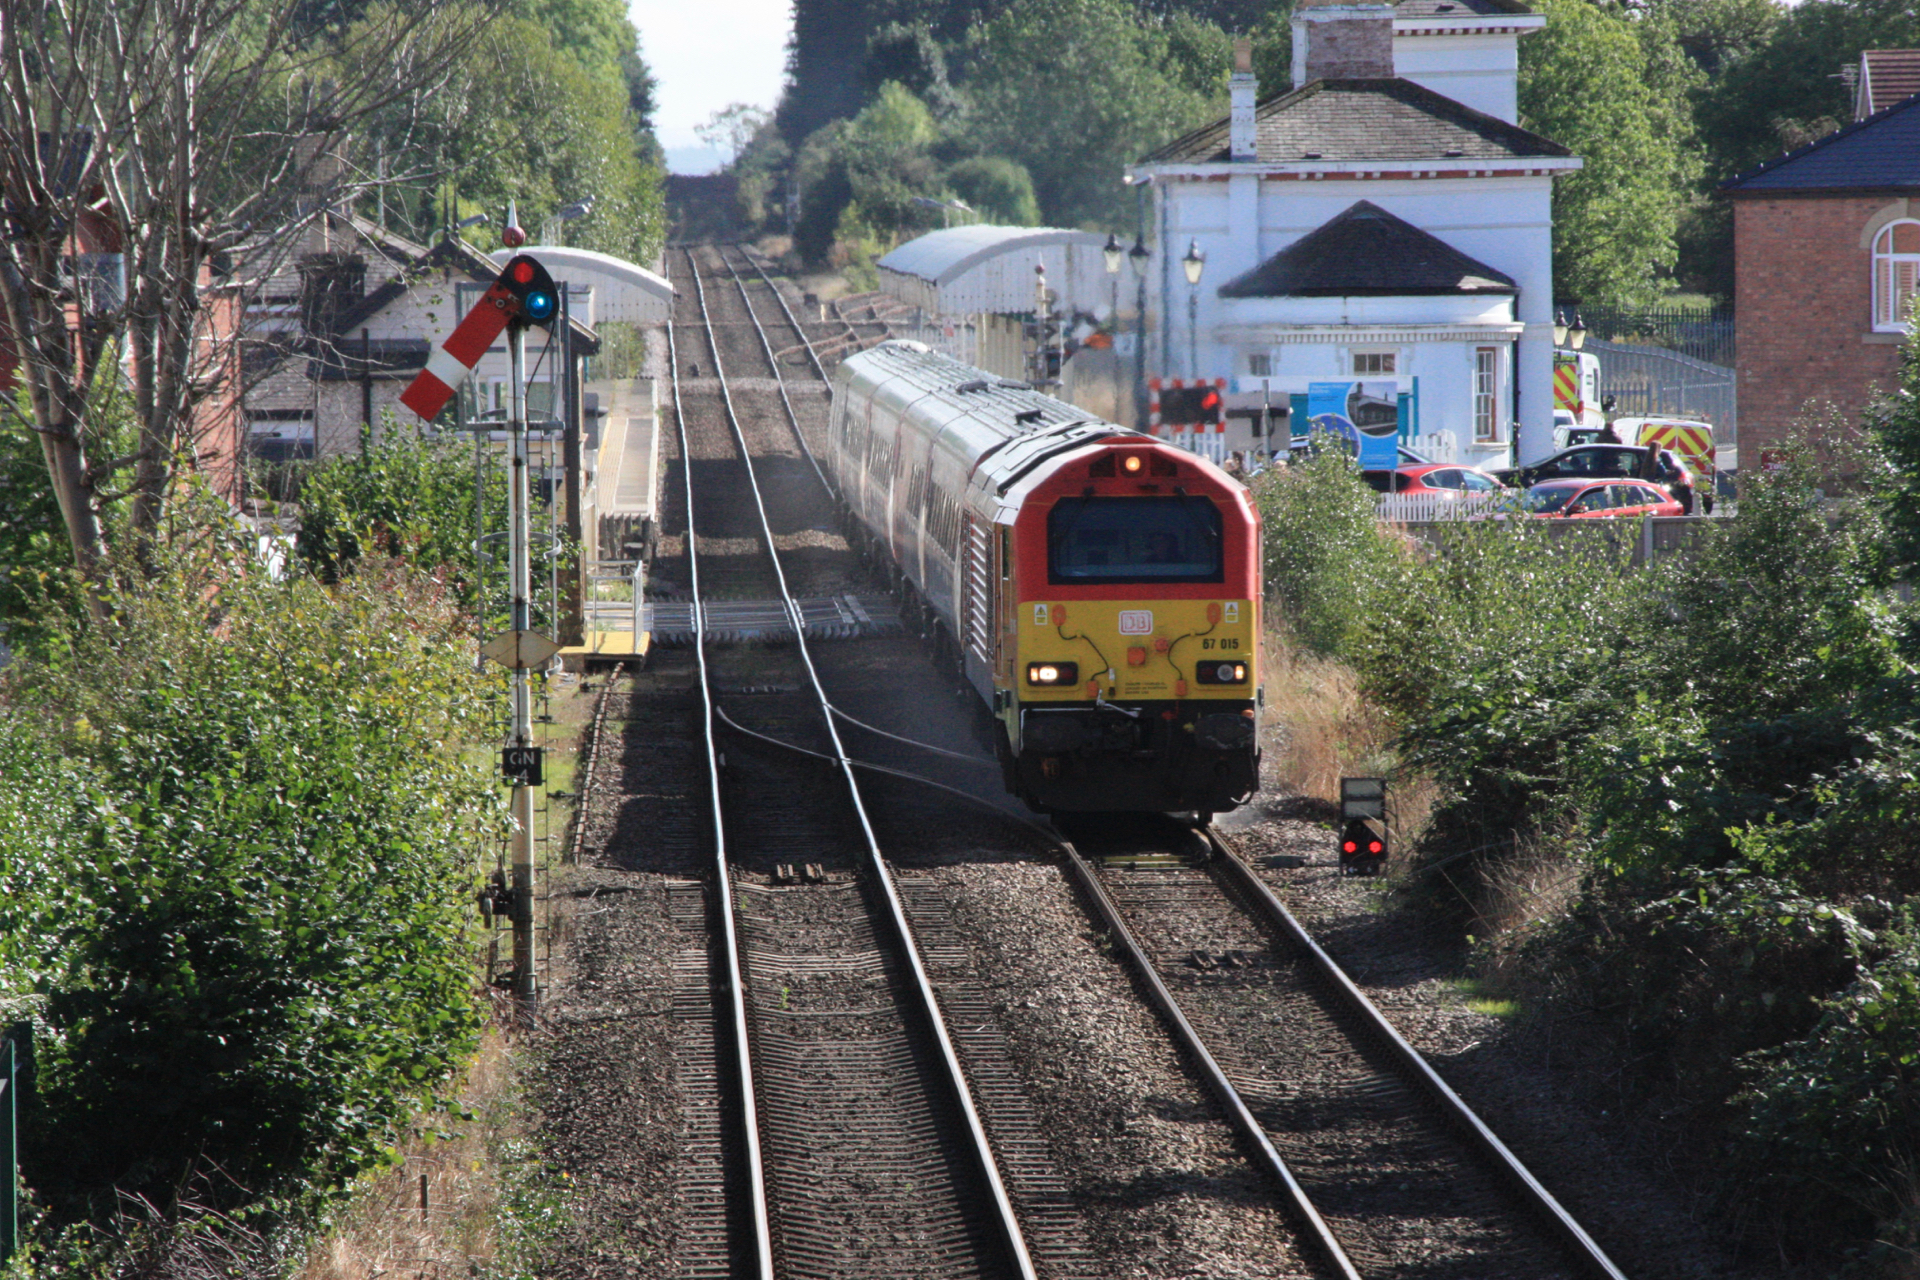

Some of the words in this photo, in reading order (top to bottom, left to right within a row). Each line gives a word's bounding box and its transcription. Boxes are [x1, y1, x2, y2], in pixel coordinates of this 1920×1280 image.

[1123, 615, 1147, 630] DB
[1202, 638, 1216, 650] 67
[1220, 638, 1240, 650] 015
